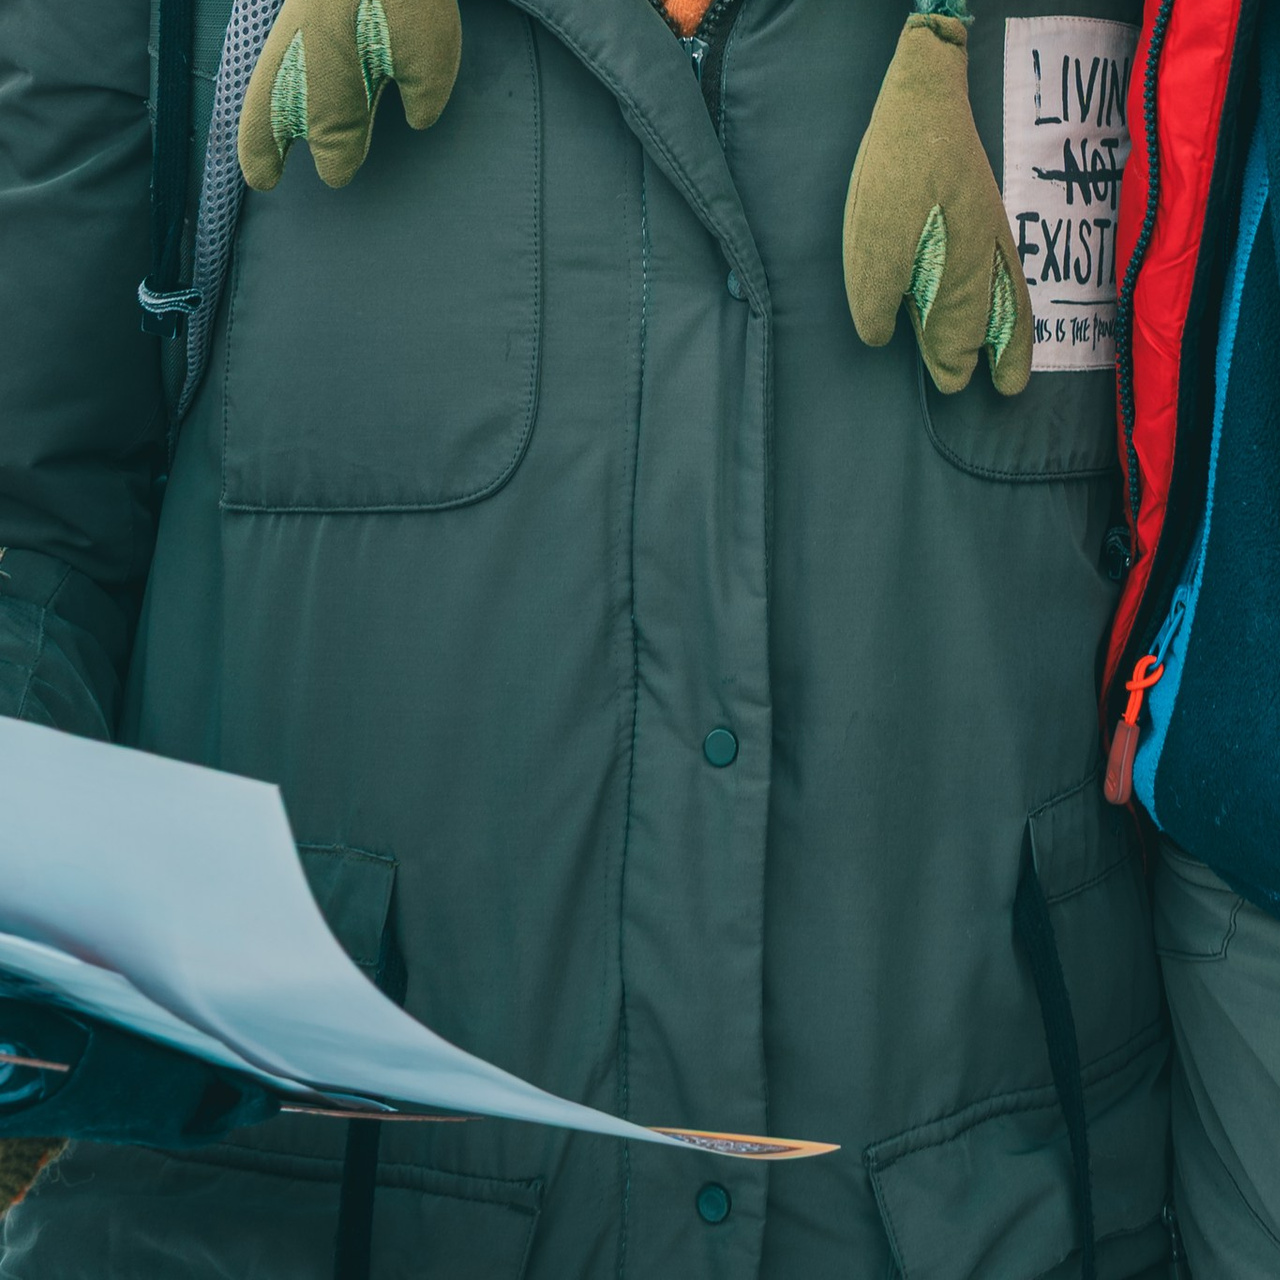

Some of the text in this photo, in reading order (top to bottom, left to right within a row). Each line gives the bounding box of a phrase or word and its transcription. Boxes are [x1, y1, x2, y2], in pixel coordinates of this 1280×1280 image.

[1033, 314, 1052, 345] HIS
[1055, 317, 1066, 343] IS
[1070, 316, 1090, 347] THE
